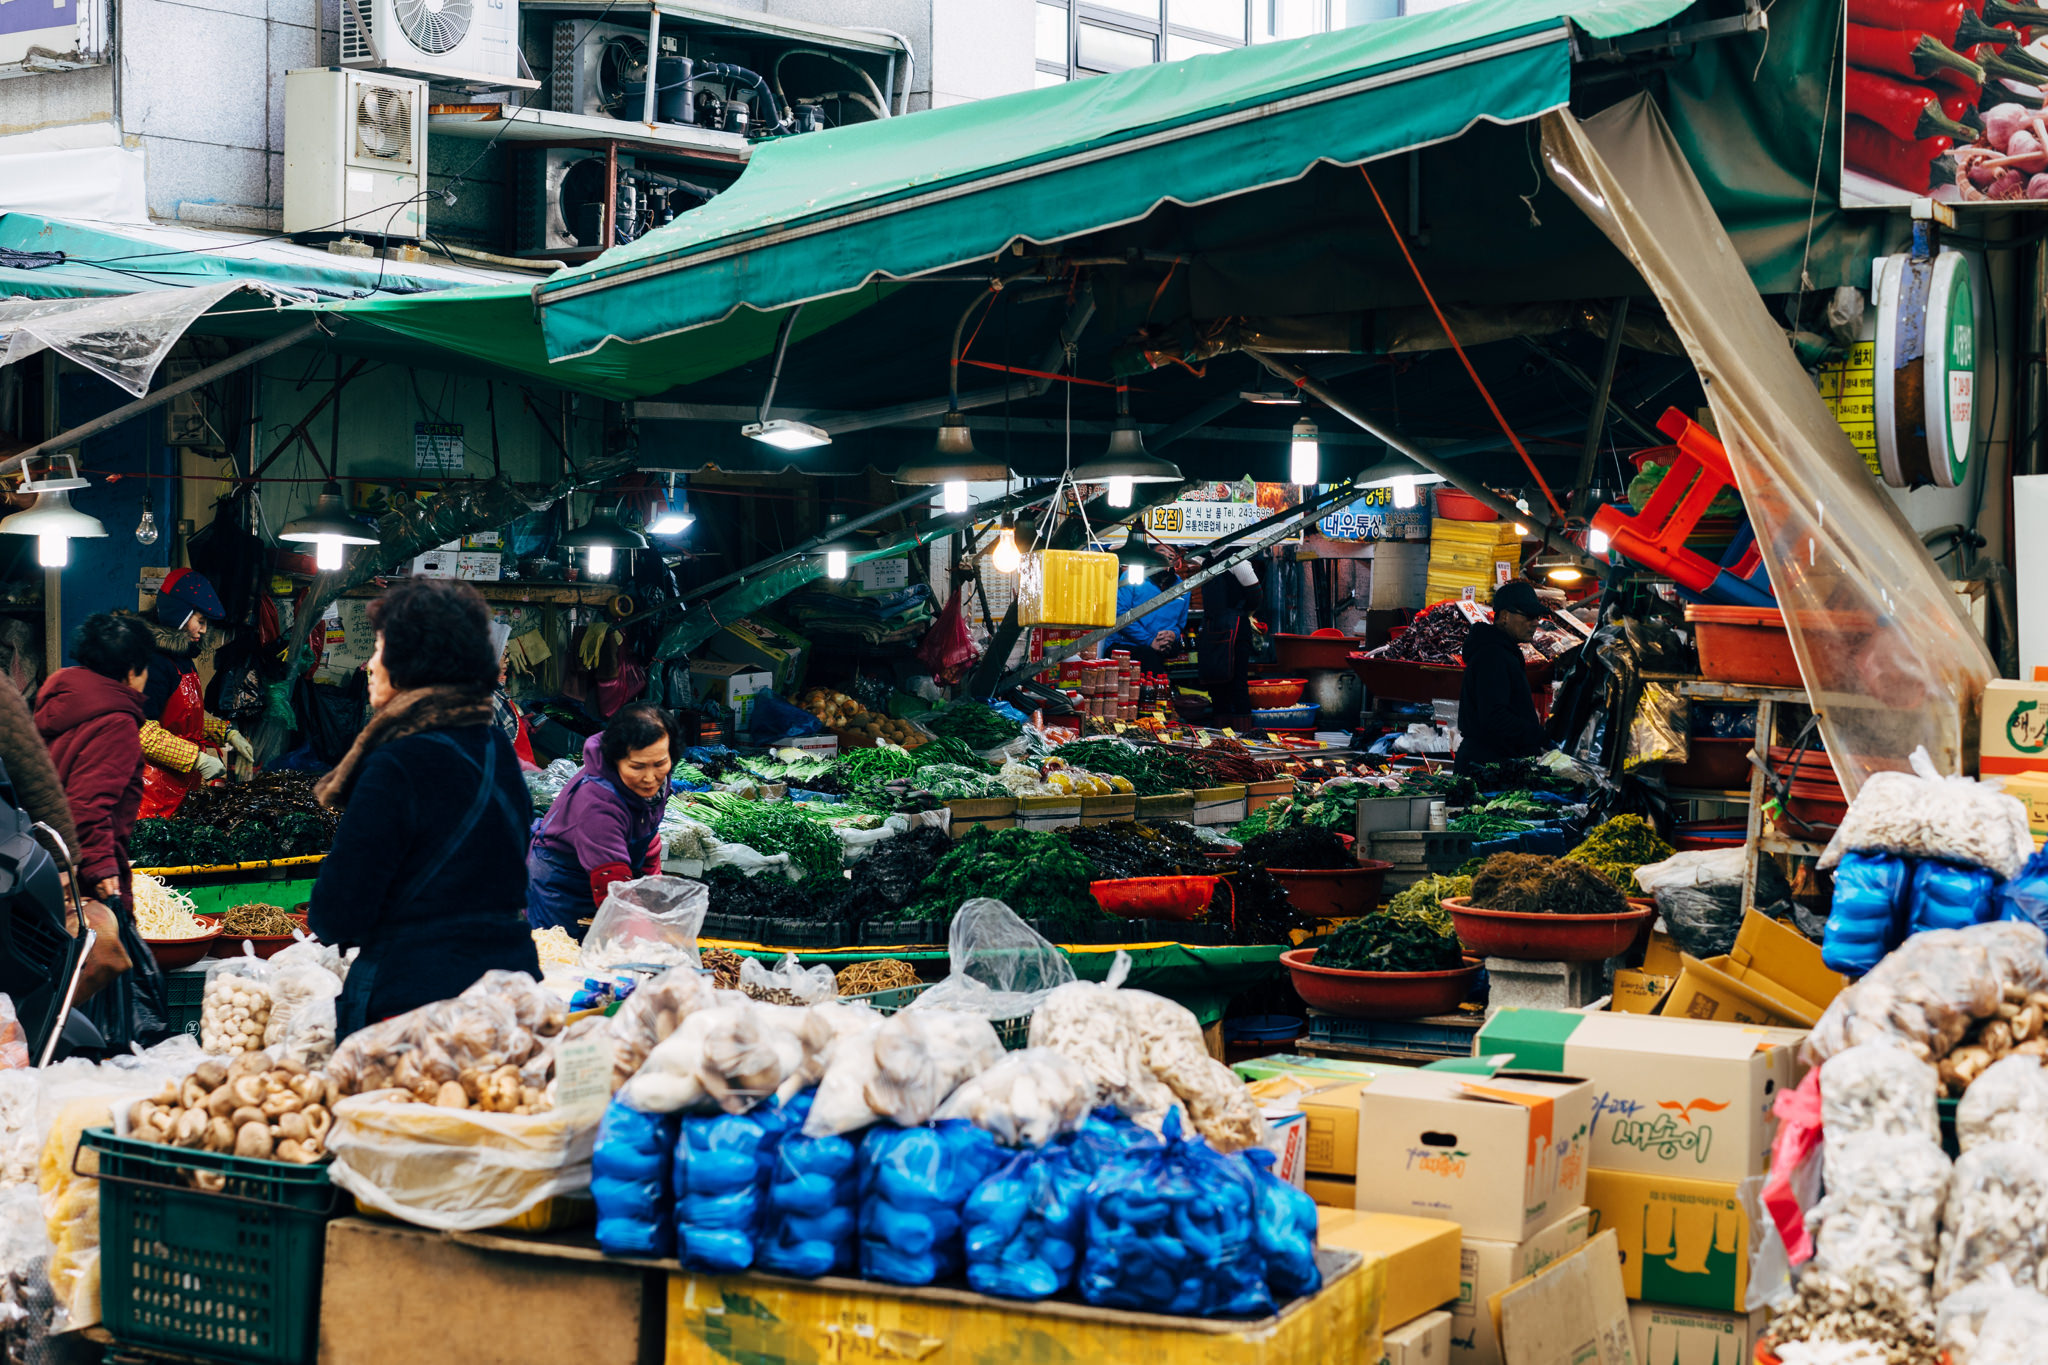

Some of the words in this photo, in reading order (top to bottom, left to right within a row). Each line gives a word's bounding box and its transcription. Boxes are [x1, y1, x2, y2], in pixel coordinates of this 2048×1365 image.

[488, 0, 503, 9] LG
[1854, 349, 1872, 365] 설치
[1840, 404, 1859, 414] 24시간
[1185, 520, 1221, 532] 유통전문업체
[1324, 512, 1382, 539] 대우통상
[1611, 1112, 1713, 1164] 새송이
